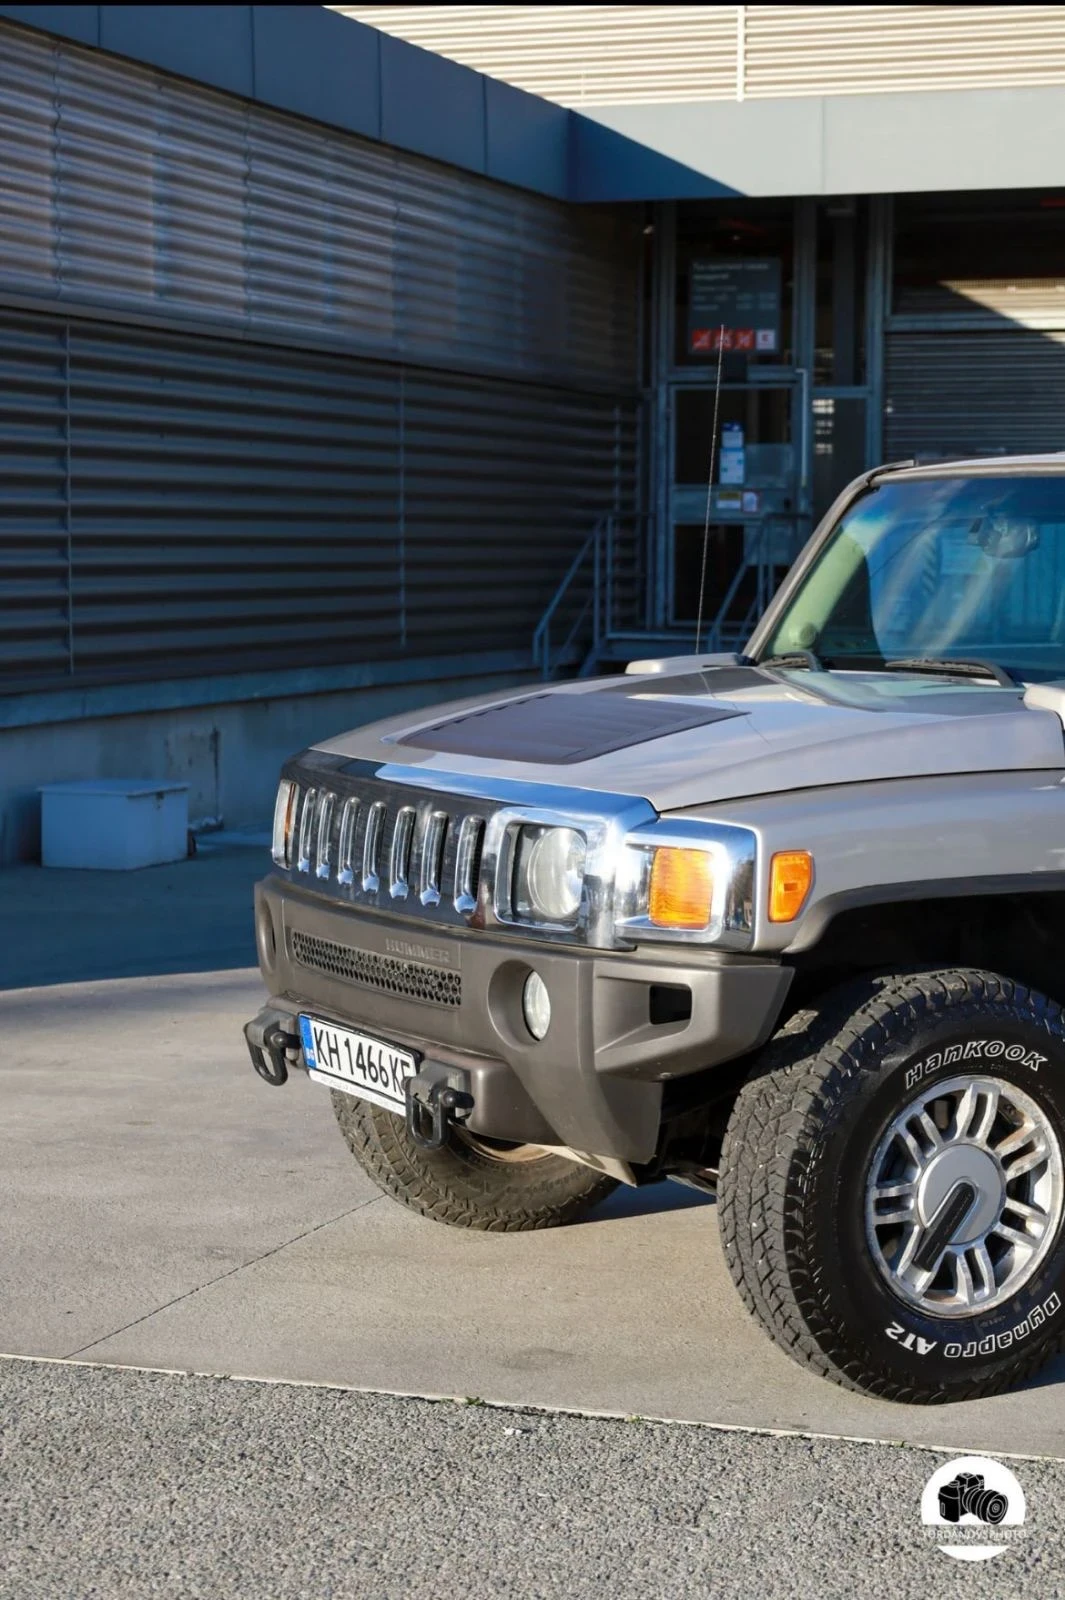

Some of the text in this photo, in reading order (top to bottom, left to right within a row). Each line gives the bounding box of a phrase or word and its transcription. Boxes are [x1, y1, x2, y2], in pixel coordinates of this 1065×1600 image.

[385, 938, 450, 963] HUMMER
[313, 1026, 342, 1071] KH
[344, 1037, 389, 1088] 1466
[884, 1291, 1062, 1358] Dynapro AT2
